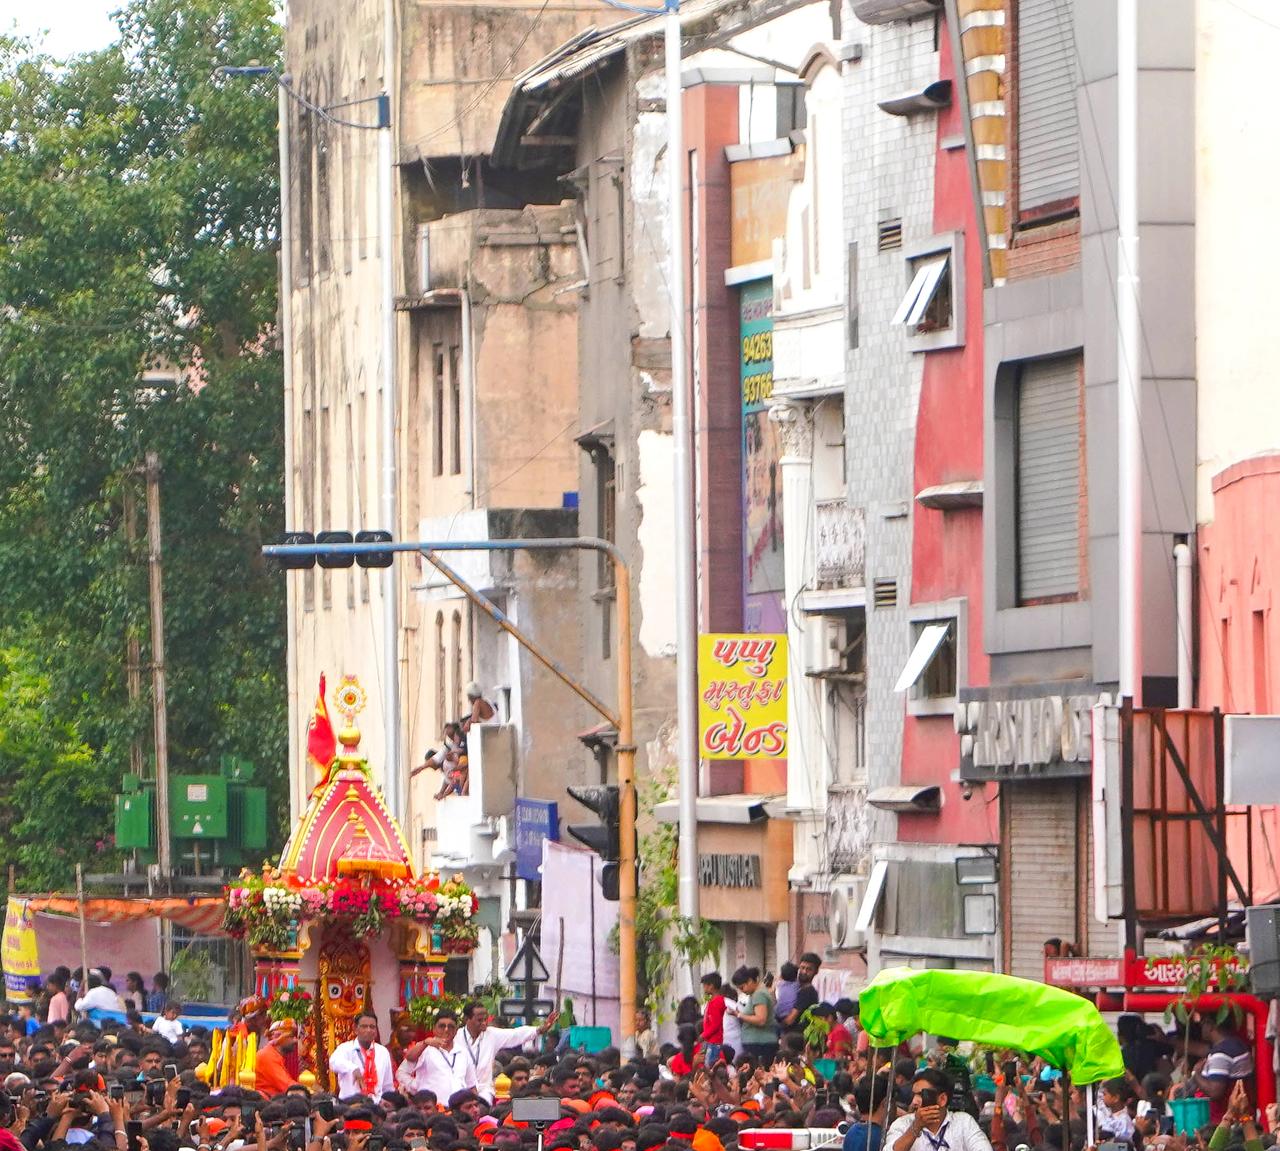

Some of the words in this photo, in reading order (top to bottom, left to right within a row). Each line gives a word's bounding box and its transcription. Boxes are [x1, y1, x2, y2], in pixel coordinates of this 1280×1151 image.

[713, 639, 776, 677] પપ્પુ
[704, 679, 786, 711] મુસ્તુફા
[704, 706, 787, 756] બેન્ડ
